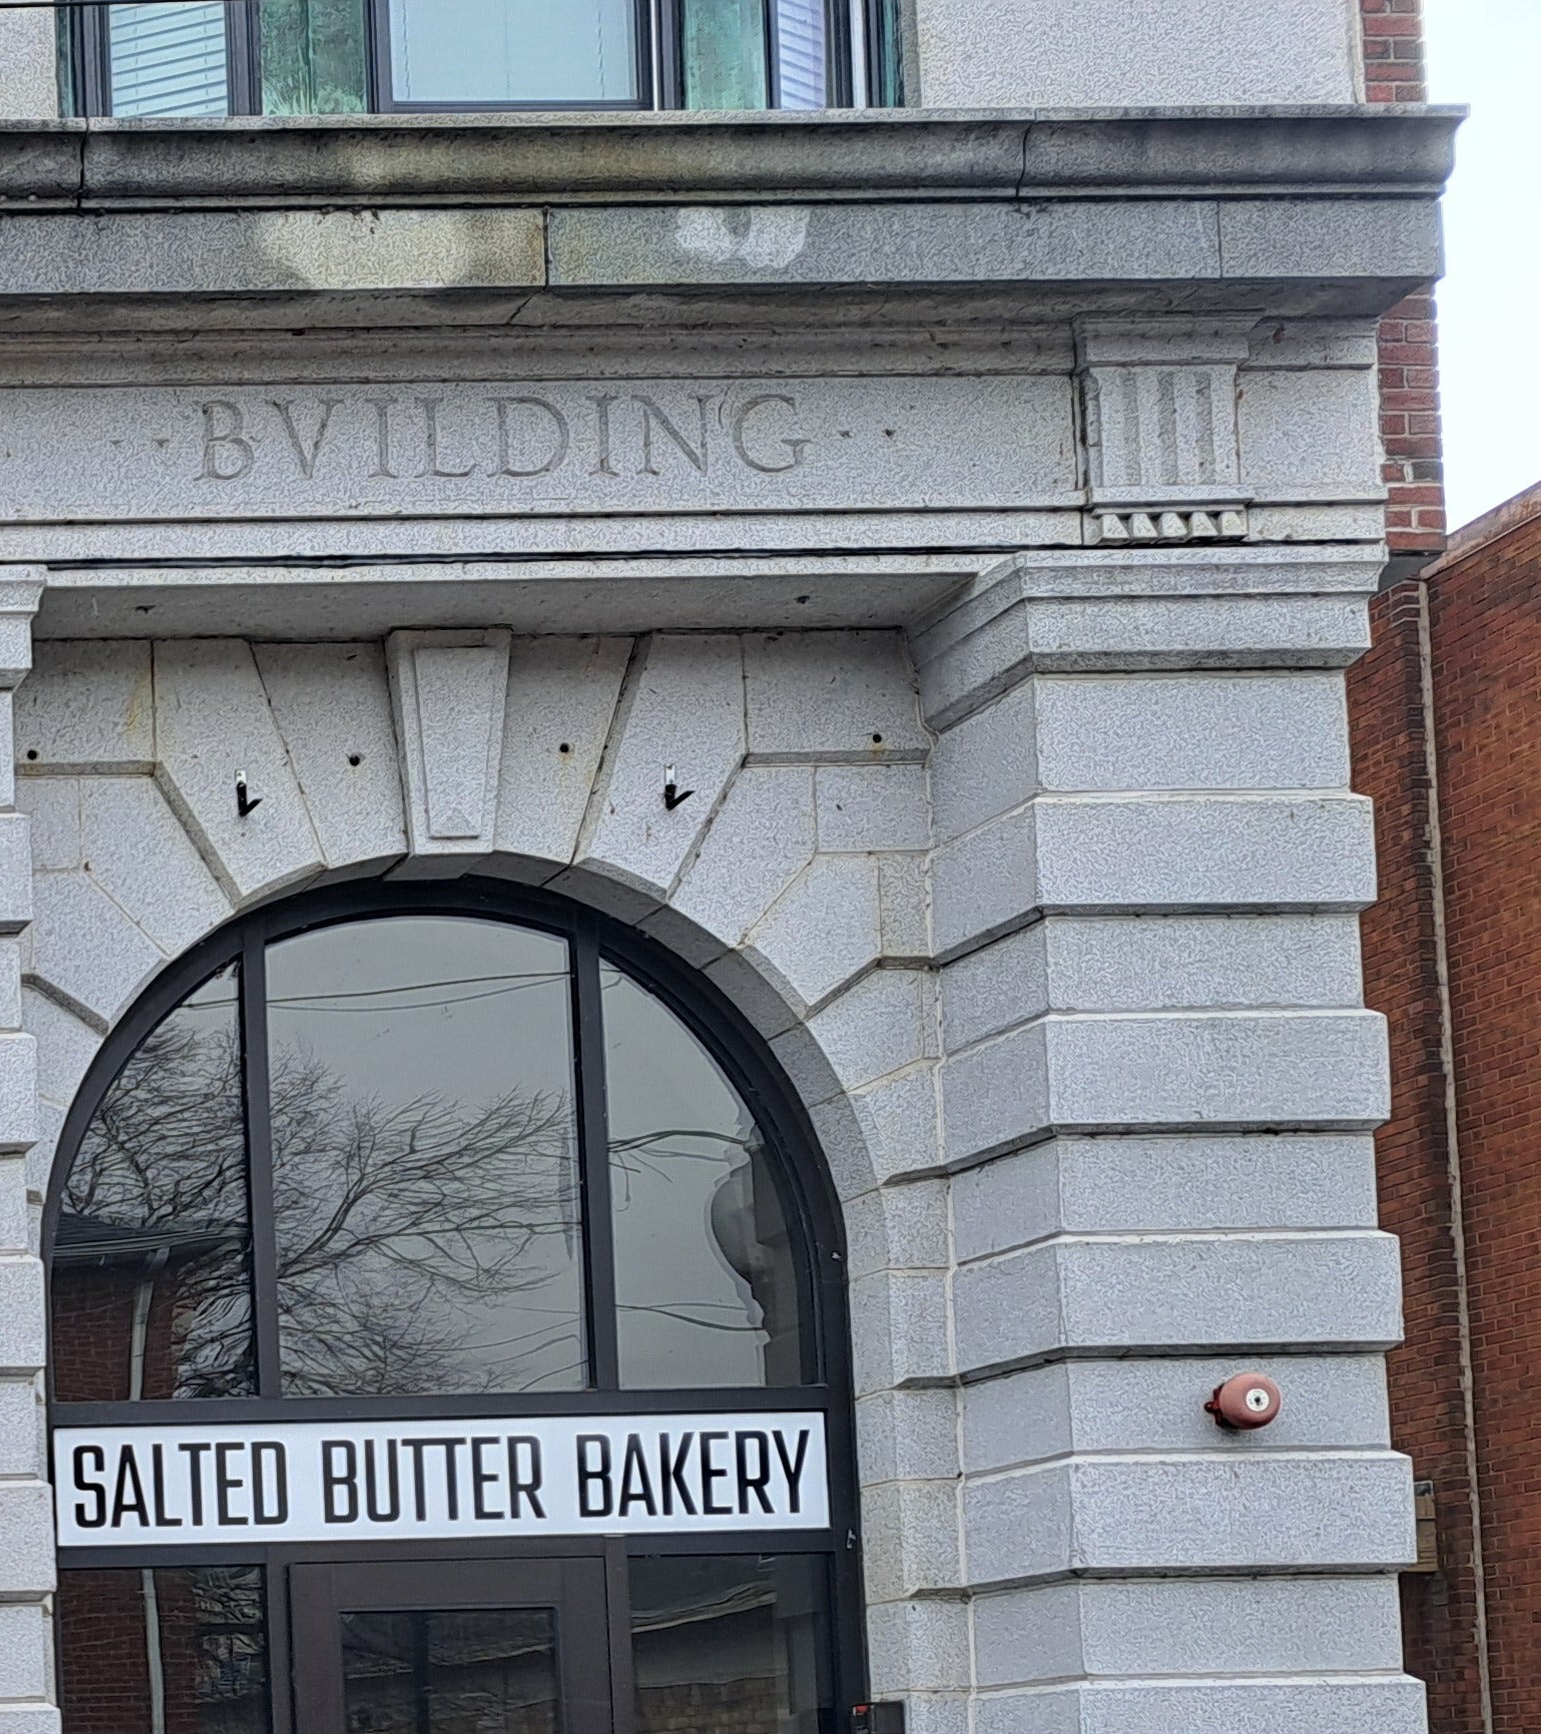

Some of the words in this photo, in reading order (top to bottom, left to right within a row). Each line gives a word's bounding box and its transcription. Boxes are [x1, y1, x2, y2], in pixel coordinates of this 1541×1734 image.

[194, 394, 813, 481] BVILDING
[73, 1441, 289, 1528] SALTED
[322, 1435, 548, 1523] BUTTER
[576, 1429, 810, 1518] BAKERY
